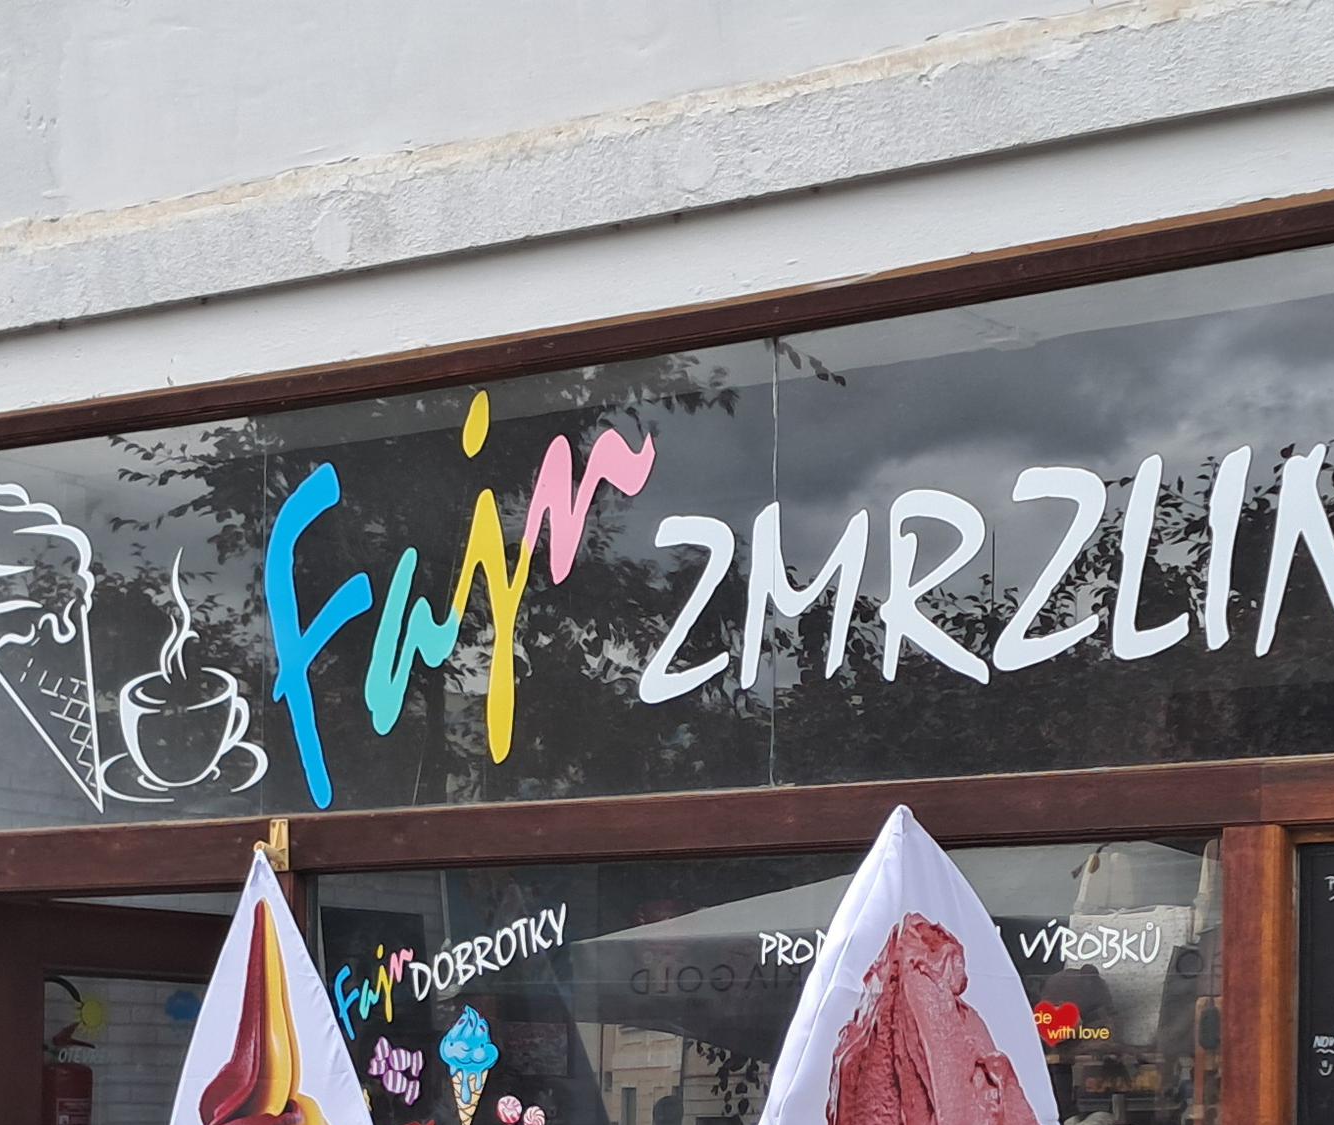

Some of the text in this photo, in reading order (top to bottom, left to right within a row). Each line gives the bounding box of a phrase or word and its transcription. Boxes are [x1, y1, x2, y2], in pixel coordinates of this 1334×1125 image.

[265, 389, 656, 809] Fajn
[334, 902, 567, 1041] Fajn DOBROTKY
[1019, 918, 1161, 969] VÝROBKŮ
[1047, 1026, 1110, 1040] with love
